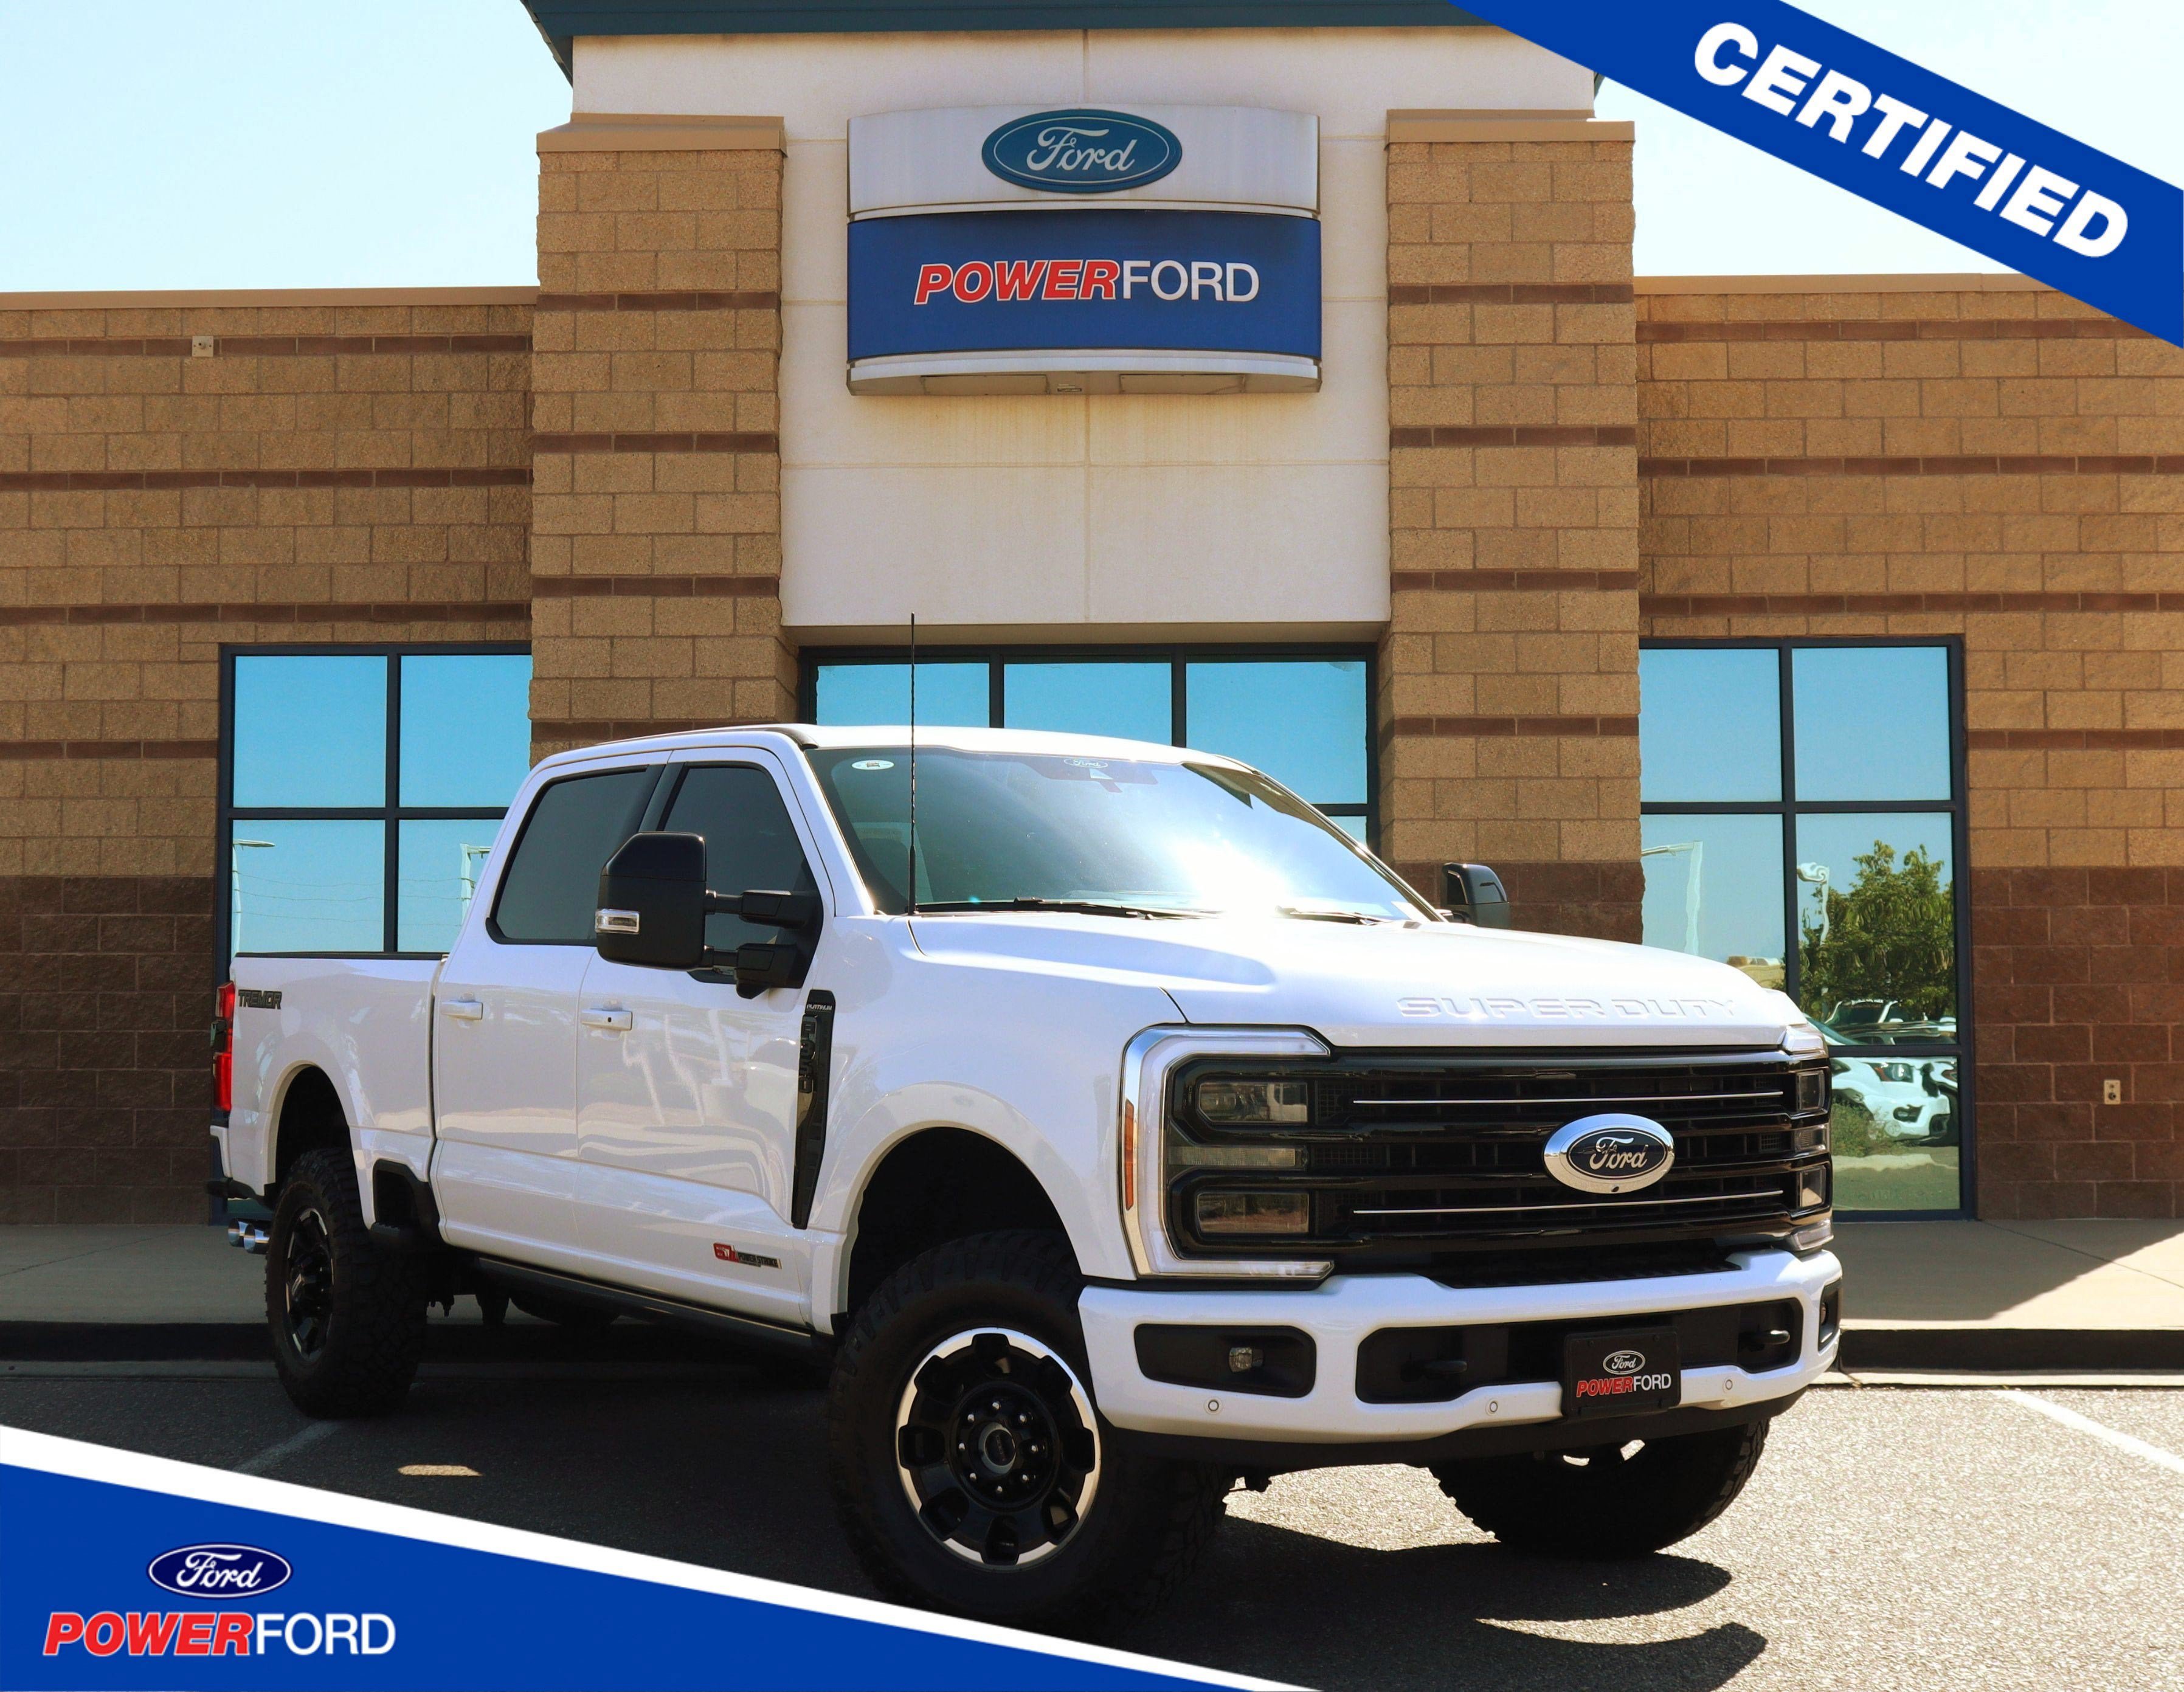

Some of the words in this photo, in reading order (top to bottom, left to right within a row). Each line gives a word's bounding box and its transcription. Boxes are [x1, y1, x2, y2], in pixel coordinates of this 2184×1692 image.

[1026, 126, 1138, 171] Ford
[238, 989, 282, 1009] TREMOR
[1397, 997, 1606, 1018] SUPER
[1611, 999, 1736, 1018] DUTY
[1589, 1136, 1648, 1170] Ford
[1611, 1355, 1637, 1370] Ford
